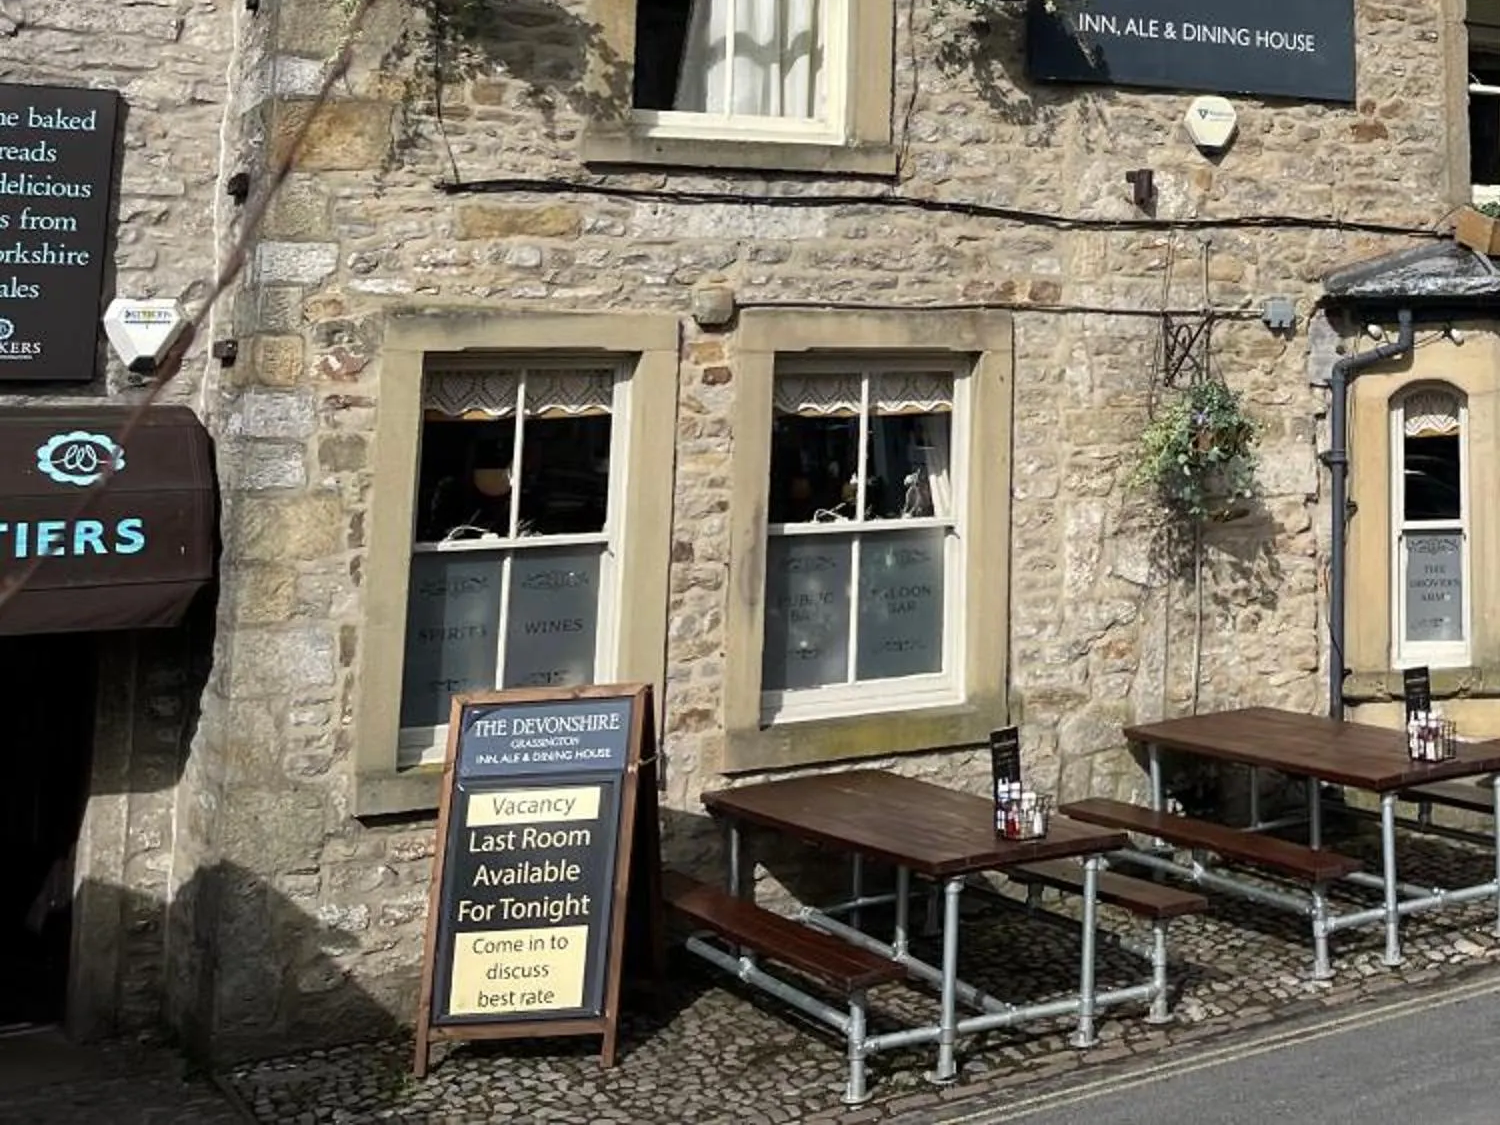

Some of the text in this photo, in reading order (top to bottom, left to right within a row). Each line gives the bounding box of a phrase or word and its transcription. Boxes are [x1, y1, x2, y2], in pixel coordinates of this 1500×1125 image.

[1079, 12, 1315, 52] INN, ALE & DINING HOUSE
[29, 107, 97, 131] baked
[0, 140, 57, 162] reads
[20, 207, 77, 232] from
[0, 241, 90, 266] rkshire
[0, 276, 40, 298] ales
[525, 618, 583, 635] WINES
[475, 713, 621, 737] THE DEVONSHIRE
[510, 736, 580, 750] GRASSINGTON
[532, 750, 573, 762] DINING
[575, 748, 612, 759] HOUSE
[492, 794, 578, 817] Vacancy
[469, 827, 591, 853] Last Room
[472, 858, 581, 887] Available
[458, 894, 591, 925] For Tonight
[472, 934, 568, 955] Come in to
[486, 962, 550, 981] discuss
[477, 988, 555, 1009] best rate
